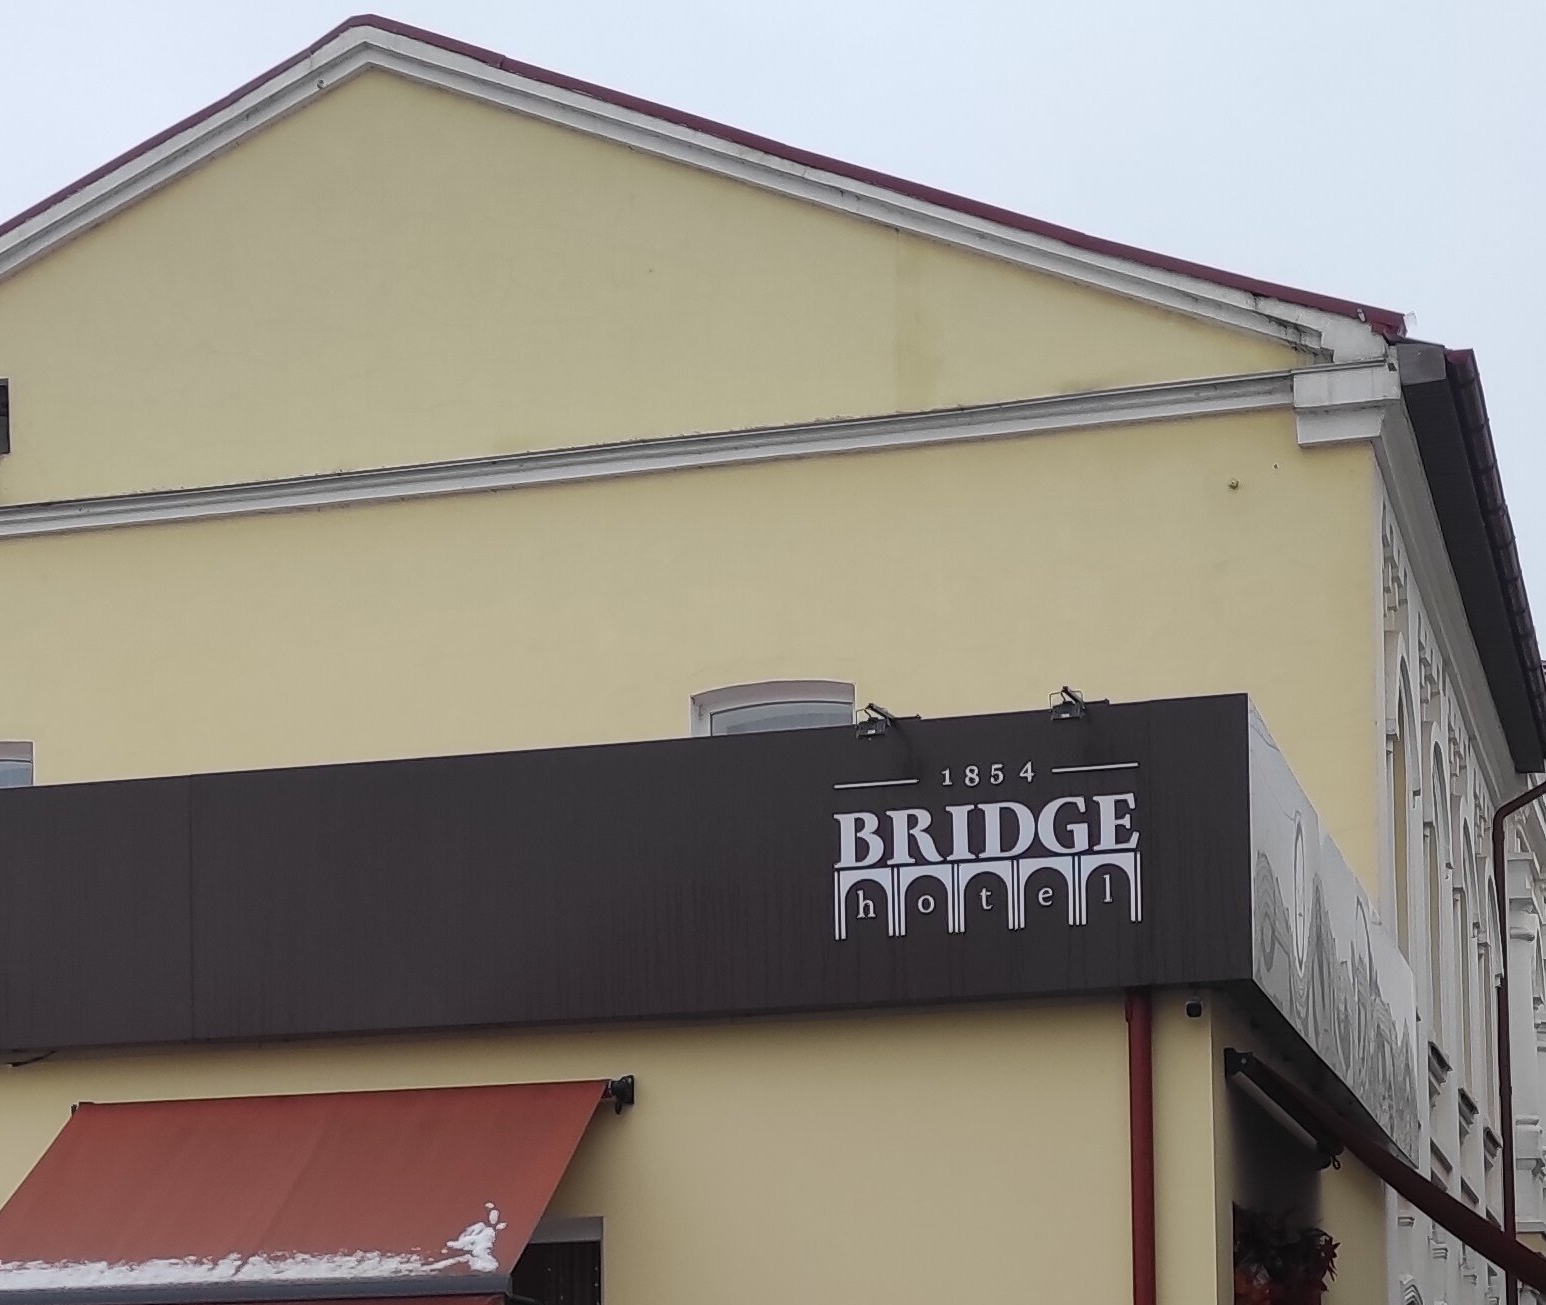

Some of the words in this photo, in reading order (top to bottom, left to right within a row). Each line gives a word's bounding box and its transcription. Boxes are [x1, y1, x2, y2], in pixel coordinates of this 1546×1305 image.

[941, 761, 1035, 787] 1854
[834, 793, 1140, 868] BRIDGE
[856, 874, 1113, 918] hotel
